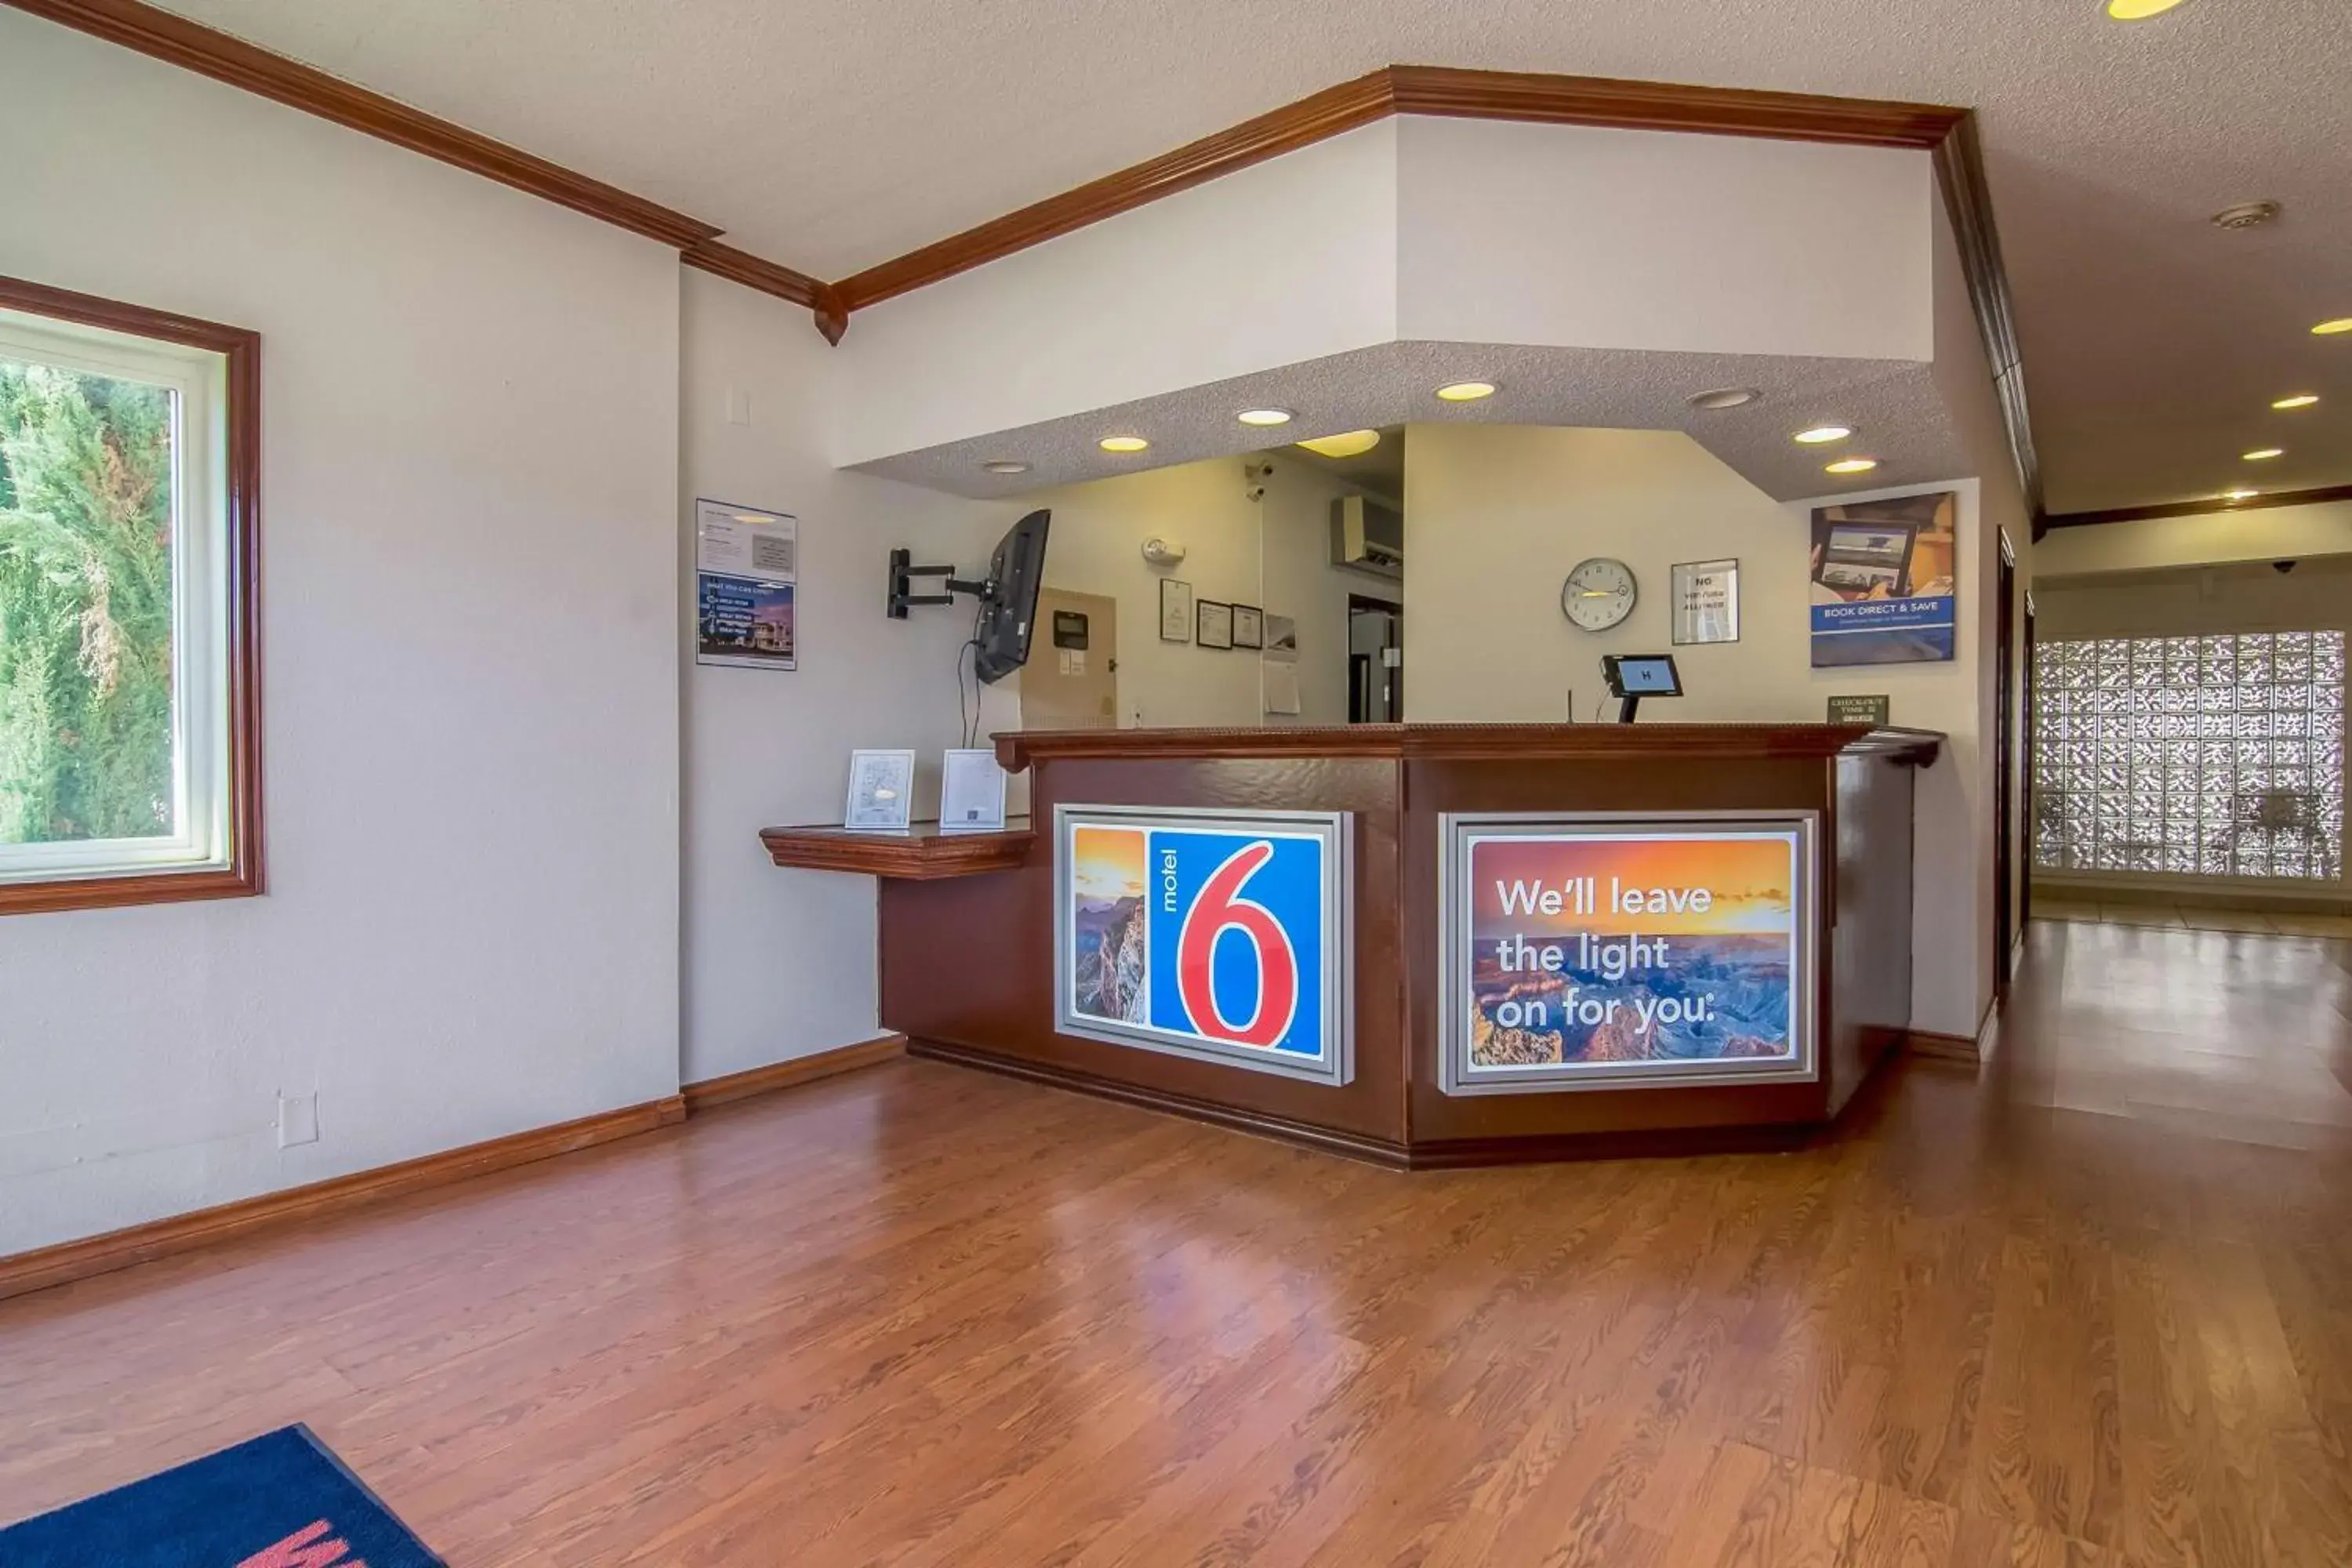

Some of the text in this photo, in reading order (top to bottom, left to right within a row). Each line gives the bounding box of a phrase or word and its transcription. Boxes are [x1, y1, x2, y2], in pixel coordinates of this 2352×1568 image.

[1696, 577, 1711, 586] NO
[1824, 601, 1938, 618] BOOK DIRECT & SAVE
[1160, 849, 1177, 913] motel
[1496, 877, 1713, 916] We'll leave
[1177, 840, 1299, 1051] 6
[1496, 931, 1669, 982] the light
[1497, 999, 1548, 1028] on
[1563, 987, 1621, 1026] for
